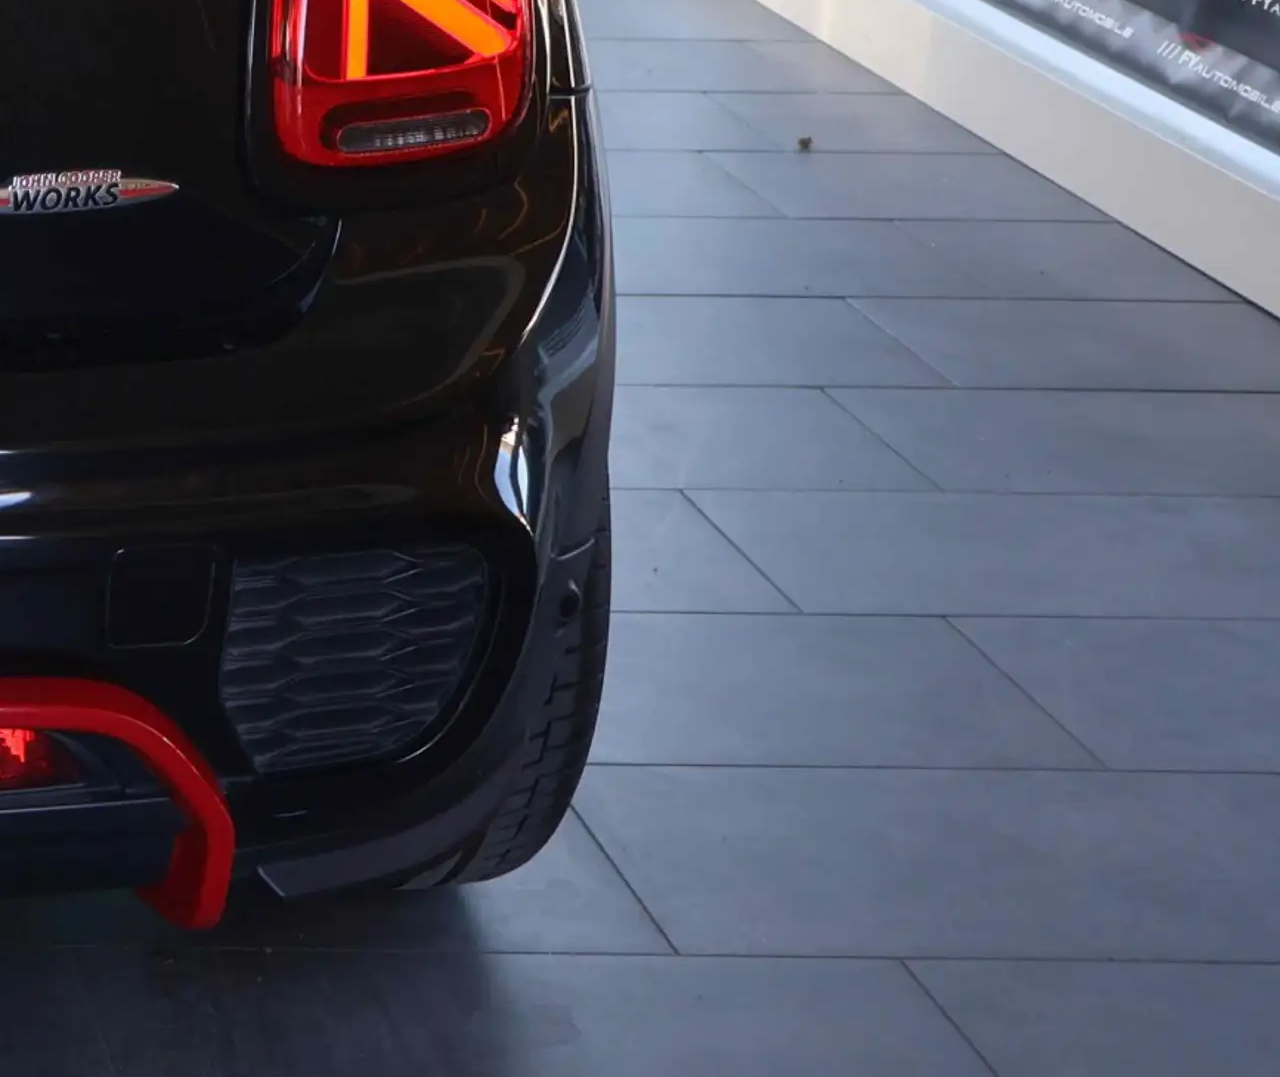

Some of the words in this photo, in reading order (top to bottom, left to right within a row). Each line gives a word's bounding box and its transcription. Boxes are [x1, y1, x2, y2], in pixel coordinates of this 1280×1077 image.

[12, 173, 56, 189] JOHN
[57, 169, 122, 185] COOPER
[11, 183, 120, 212] WORKS
